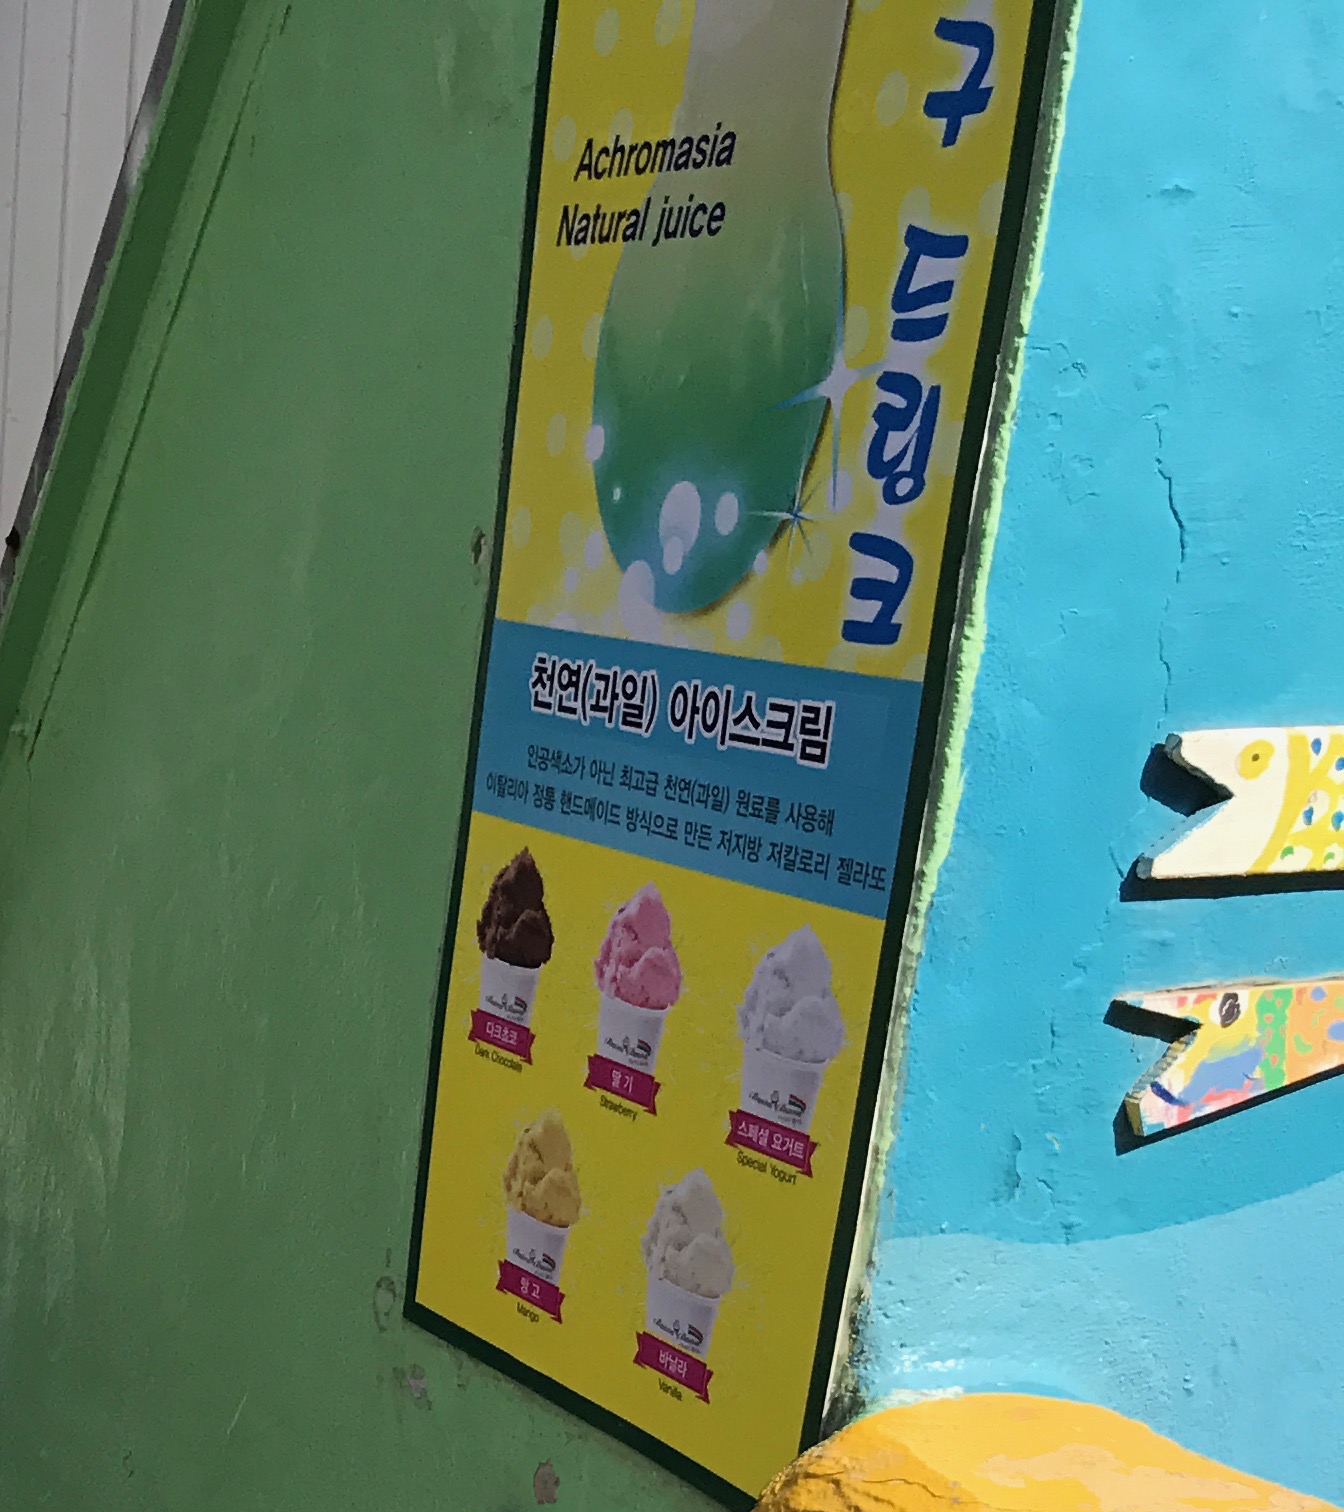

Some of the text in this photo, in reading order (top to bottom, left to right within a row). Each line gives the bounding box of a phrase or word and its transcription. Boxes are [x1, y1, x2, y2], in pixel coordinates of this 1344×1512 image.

[573, 121, 737, 182] Achromasia
[555, 193, 726, 247] Natural juice
[530, 655, 833, 765] 천연(과일) 아이스크림
[527, 744, 836, 838] 인공색소가 아닌 최고급 천연(과일) 원료를 사용해
[486, 771, 887, 892] 이탈리아 정통 핸드메이드 방식으로 만든 저지방 저칼로리 젤라또
[736, 1149, 797, 1186] Special Yogurt
[771, 1133, 805, 1159] 요거트
[658, 1349, 689, 1379] 바닐라
